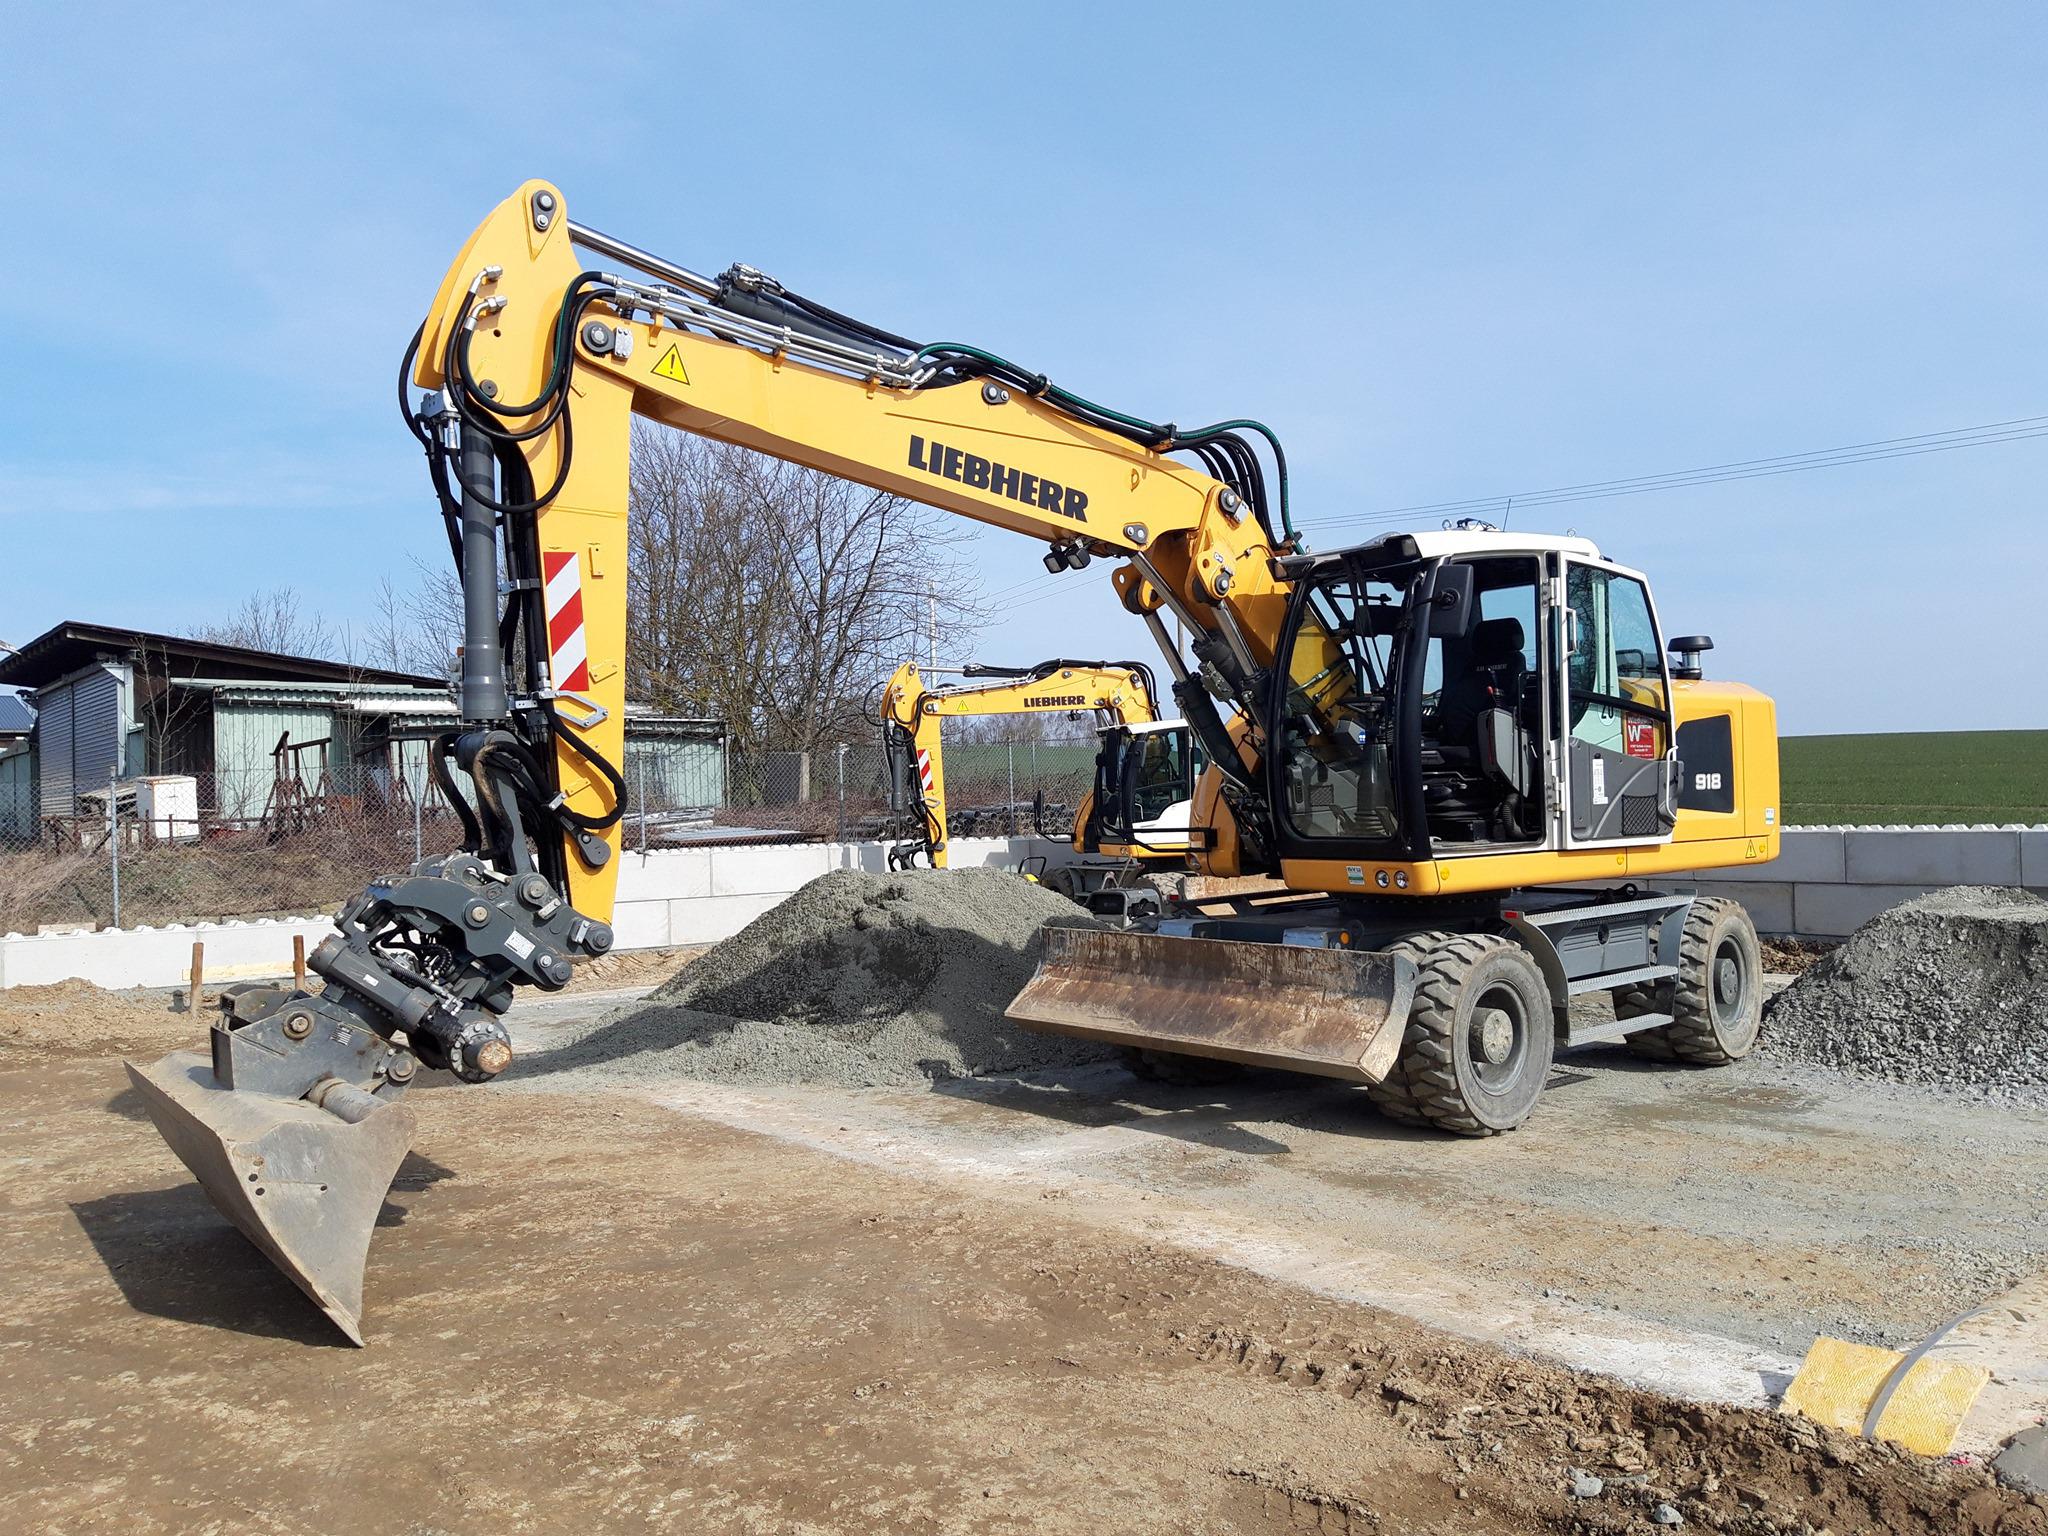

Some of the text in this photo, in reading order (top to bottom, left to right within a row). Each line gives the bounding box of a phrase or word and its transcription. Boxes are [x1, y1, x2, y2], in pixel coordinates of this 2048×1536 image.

[908, 434, 1088, 523] LIEBHERR
[1024, 695, 1085, 708] LIEBHERR
[1695, 773, 1721, 790] 918
